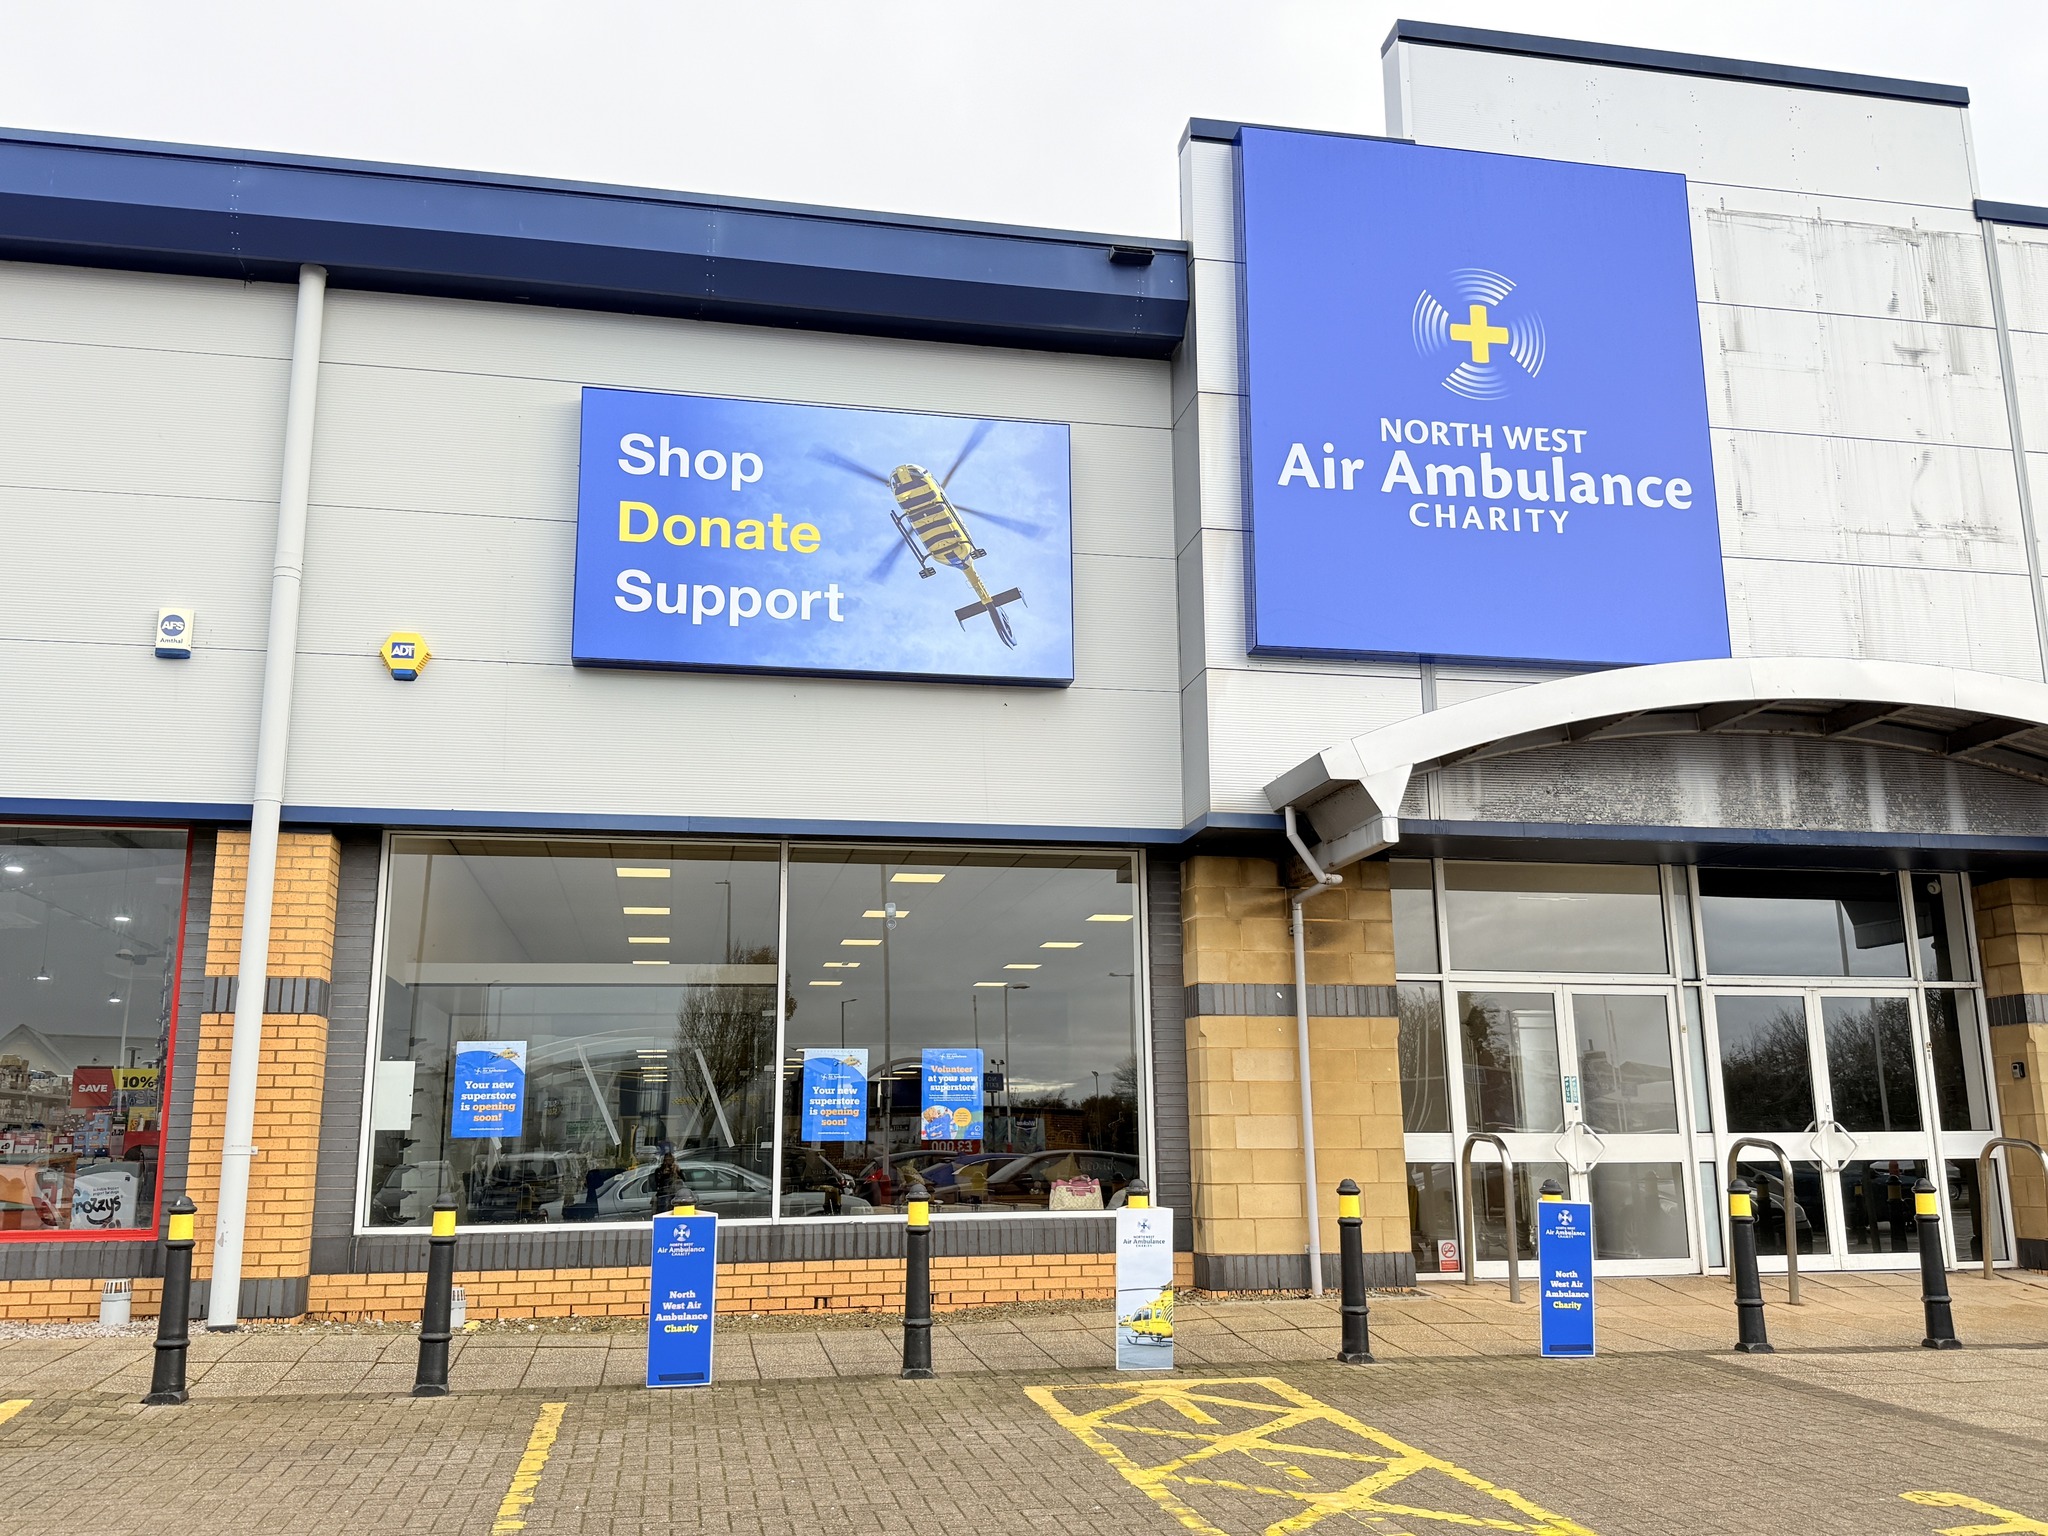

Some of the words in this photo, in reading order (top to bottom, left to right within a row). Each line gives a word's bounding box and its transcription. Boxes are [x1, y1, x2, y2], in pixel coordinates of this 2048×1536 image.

[1380, 417, 1493, 449] NORTH
[1502, 425, 1588, 454] WEST
[617, 432, 764, 492] Shop
[1277, 442, 1365, 490] Air
[1380, 449, 1693, 510] Ambulance
[1408, 502, 1569, 534] CHARITY
[617, 500, 822, 554] Donate
[614, 569, 845, 628] Support
[162, 620, 184, 631] AFS
[391, 644, 416, 657] ADT
[930, 1065, 973, 1073] Volunteer
[78, 1084, 108, 1093] SAVE
[122, 1076, 154, 1088] 10%
[464, 1081, 490, 1089] Your
[938, 1076, 958, 1084] your
[812, 1086, 835, 1095] Your
[837, 1087, 858, 1095] new
[930, 1084, 976, 1092] superstore
[460, 1092, 517, 1102] superstore
[809, 1097, 860, 1107] superstore
[460, 1102, 470, 1111] is
[472, 1102, 516, 1112] opening
[809, 1107, 818, 1115] is
[820, 1107, 859, 1117] opening
[473, 1113, 502, 1122] soon!
[821, 1118, 847, 1126] soon!
[657, 1246, 668, 1254] Air
[668, 1245, 705, 1253] Ambulance
[1555, 1270, 1578, 1278] North
[1550, 1280, 1570, 1288] West
[1570, 1280, 1584, 1288] Air
[669, 1290, 696, 1299] North
[1545, 1290, 1590, 1298] Ambulance
[662, 1302, 685, 1310] West
[686, 1301, 702, 1310] Air
[1553, 1300, 1582, 1311] Charity
[655, 1313, 708, 1322] Ambulance
[663, 1323, 699, 1334] Charity
